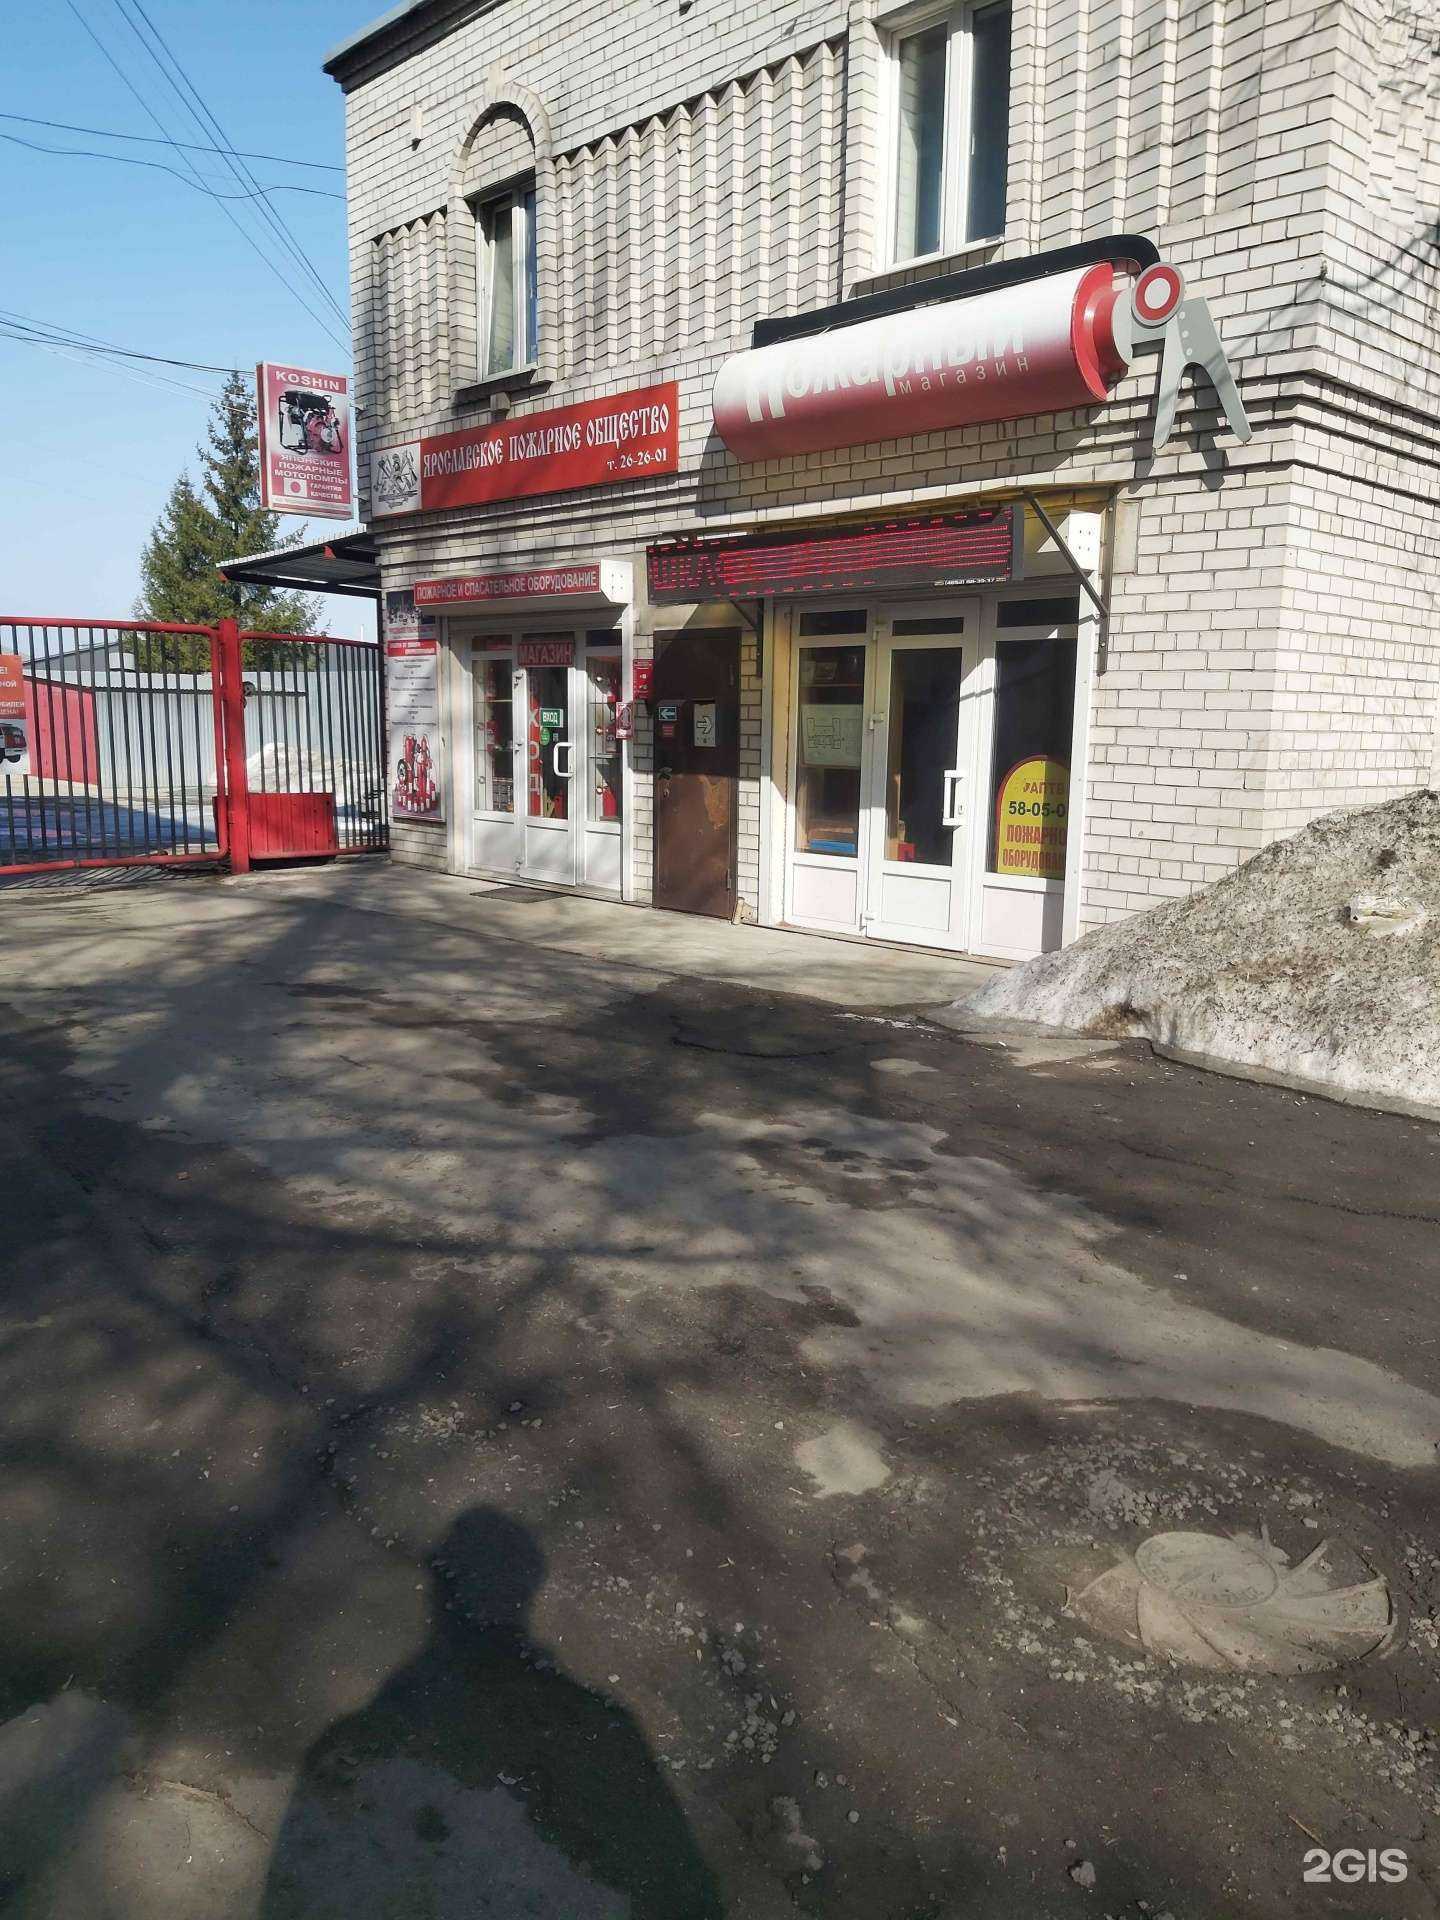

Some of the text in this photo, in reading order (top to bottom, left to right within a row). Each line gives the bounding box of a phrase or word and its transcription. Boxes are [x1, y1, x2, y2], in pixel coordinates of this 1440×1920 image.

[275, 370, 340, 391] KOSHIN
[899, 354, 1030, 395] магазин
[423, 403, 670, 478] ЯРОСЛАВСКОЕ ПОЖАРНОЕ ОБЩЕСТВО
[280, 454, 341, 468] ЯПОНСКИЕ
[620, 447, 667, 469] 26-26-01
[273, 469, 348, 485] МОТОПОМПЫ
[278, 461, 343, 477] ПОЖАРНЫЕ
[416, 571, 597, 600] ПОЖАРНОЕ И СПАСАТЕЛЬНОЕ ОБОРУДОВАНИЕ
[518, 643, 572, 665] МАГАЗИН
[543, 711, 558, 725] ВХОД
